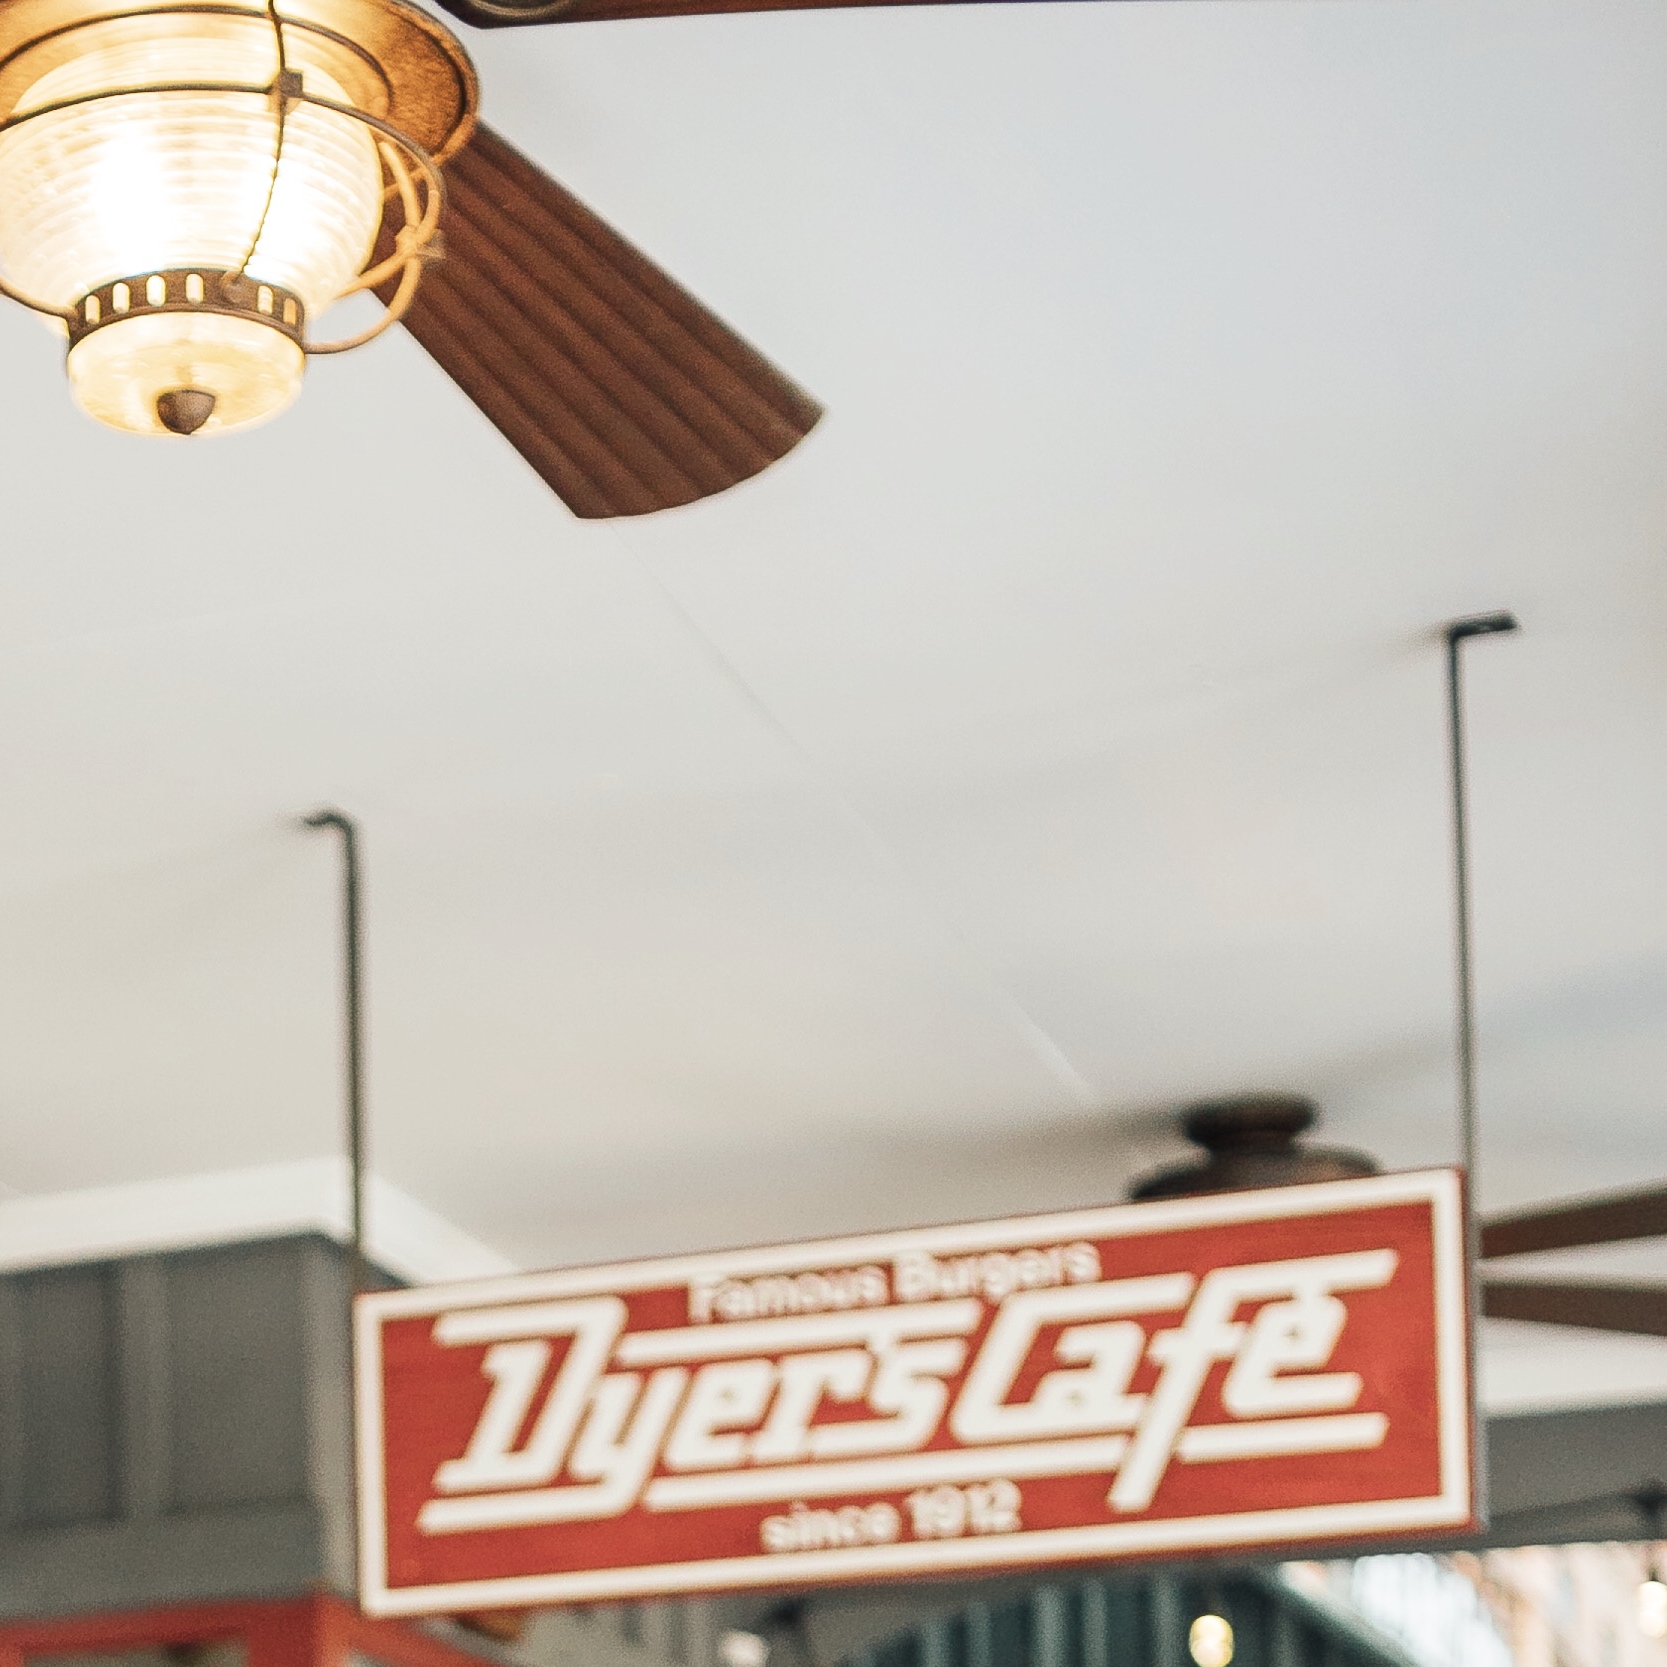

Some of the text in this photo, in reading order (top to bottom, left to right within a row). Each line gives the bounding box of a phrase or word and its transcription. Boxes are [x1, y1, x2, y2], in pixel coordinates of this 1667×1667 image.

[688, 1242, 1102, 1324] Famous Burgers
[903, 1477, 1023, 1541] 1912
